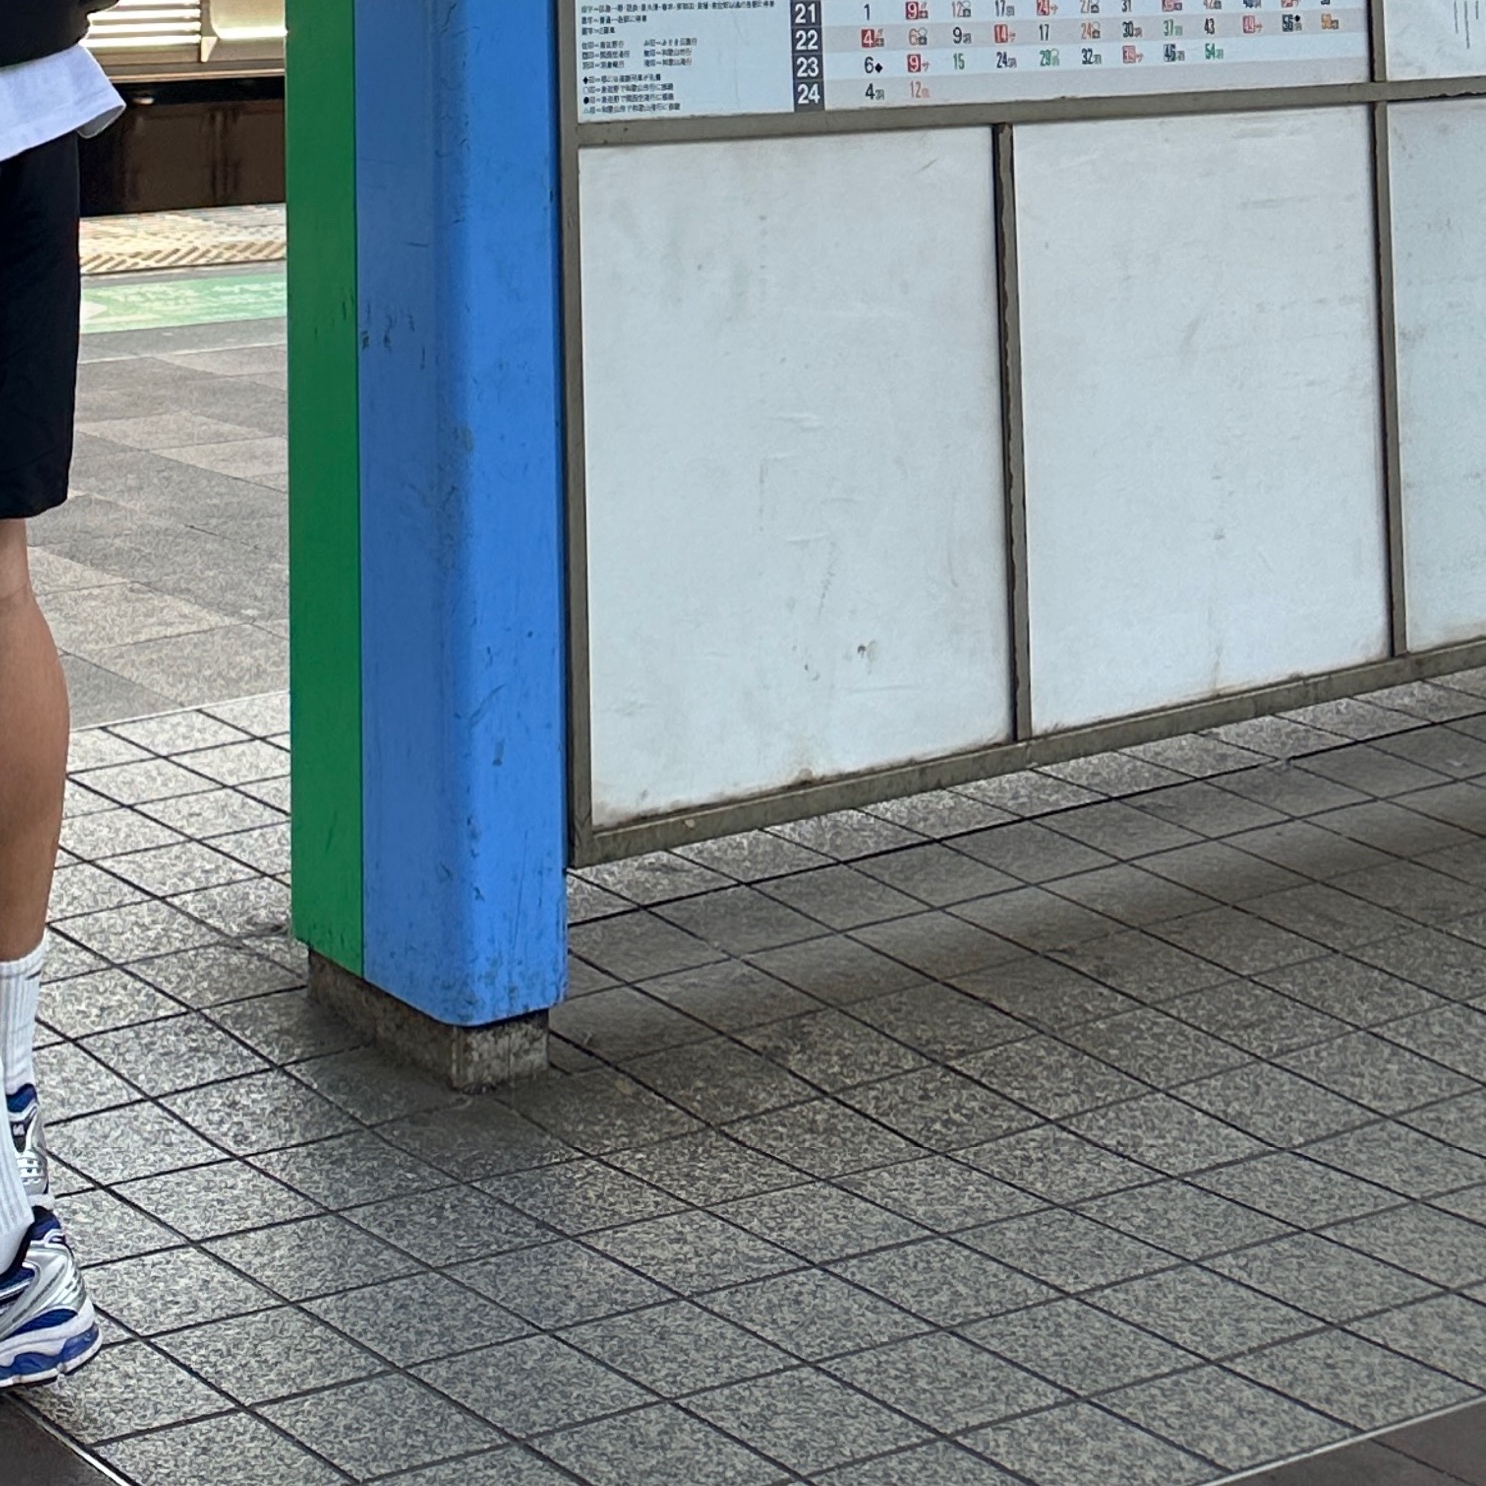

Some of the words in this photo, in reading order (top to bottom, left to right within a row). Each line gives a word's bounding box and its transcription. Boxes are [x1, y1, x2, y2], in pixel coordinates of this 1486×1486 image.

[795, 4, 816, 23] 21
[864, 4, 869, 20] 1
[795, 31, 818, 50] 22
[953, 27, 962, 43] 9
[1039, 24, 1049, 40] 17
[796, 58, 819, 77] 23
[865, 57, 874, 73] 6
[797, 85, 820, 104] 24
[865, 83, 875, 100] 4
